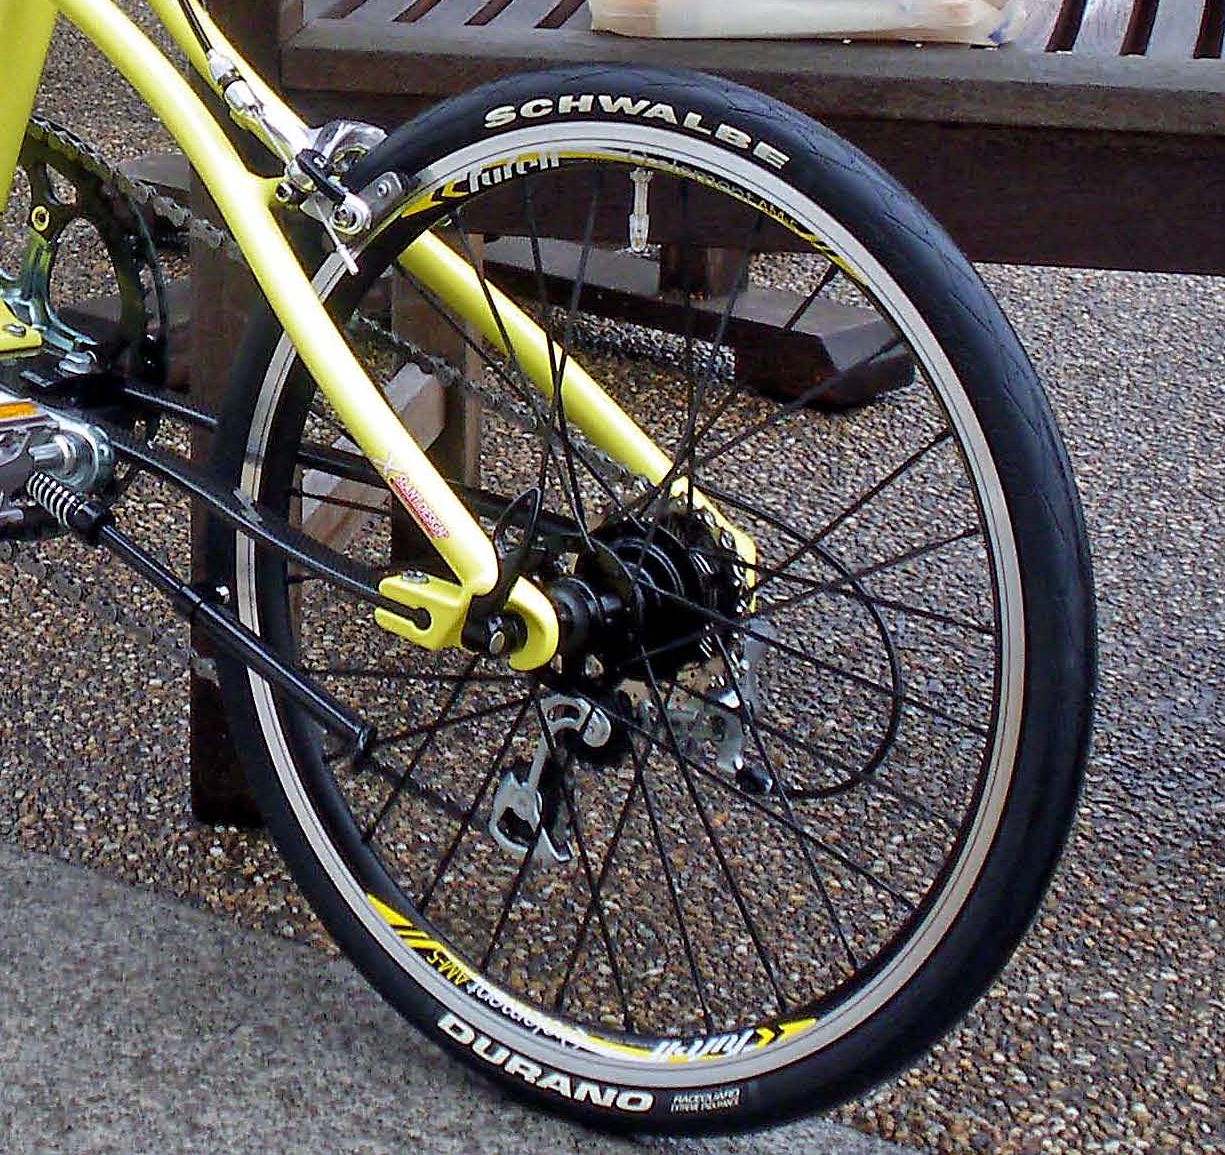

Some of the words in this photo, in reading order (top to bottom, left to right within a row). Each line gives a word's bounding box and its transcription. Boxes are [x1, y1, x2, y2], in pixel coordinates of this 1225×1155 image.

[483, 93, 791, 171] SCHWALBE
[425, 947, 470, 986] AM-5
[436, 1013, 656, 1112] DURANO
